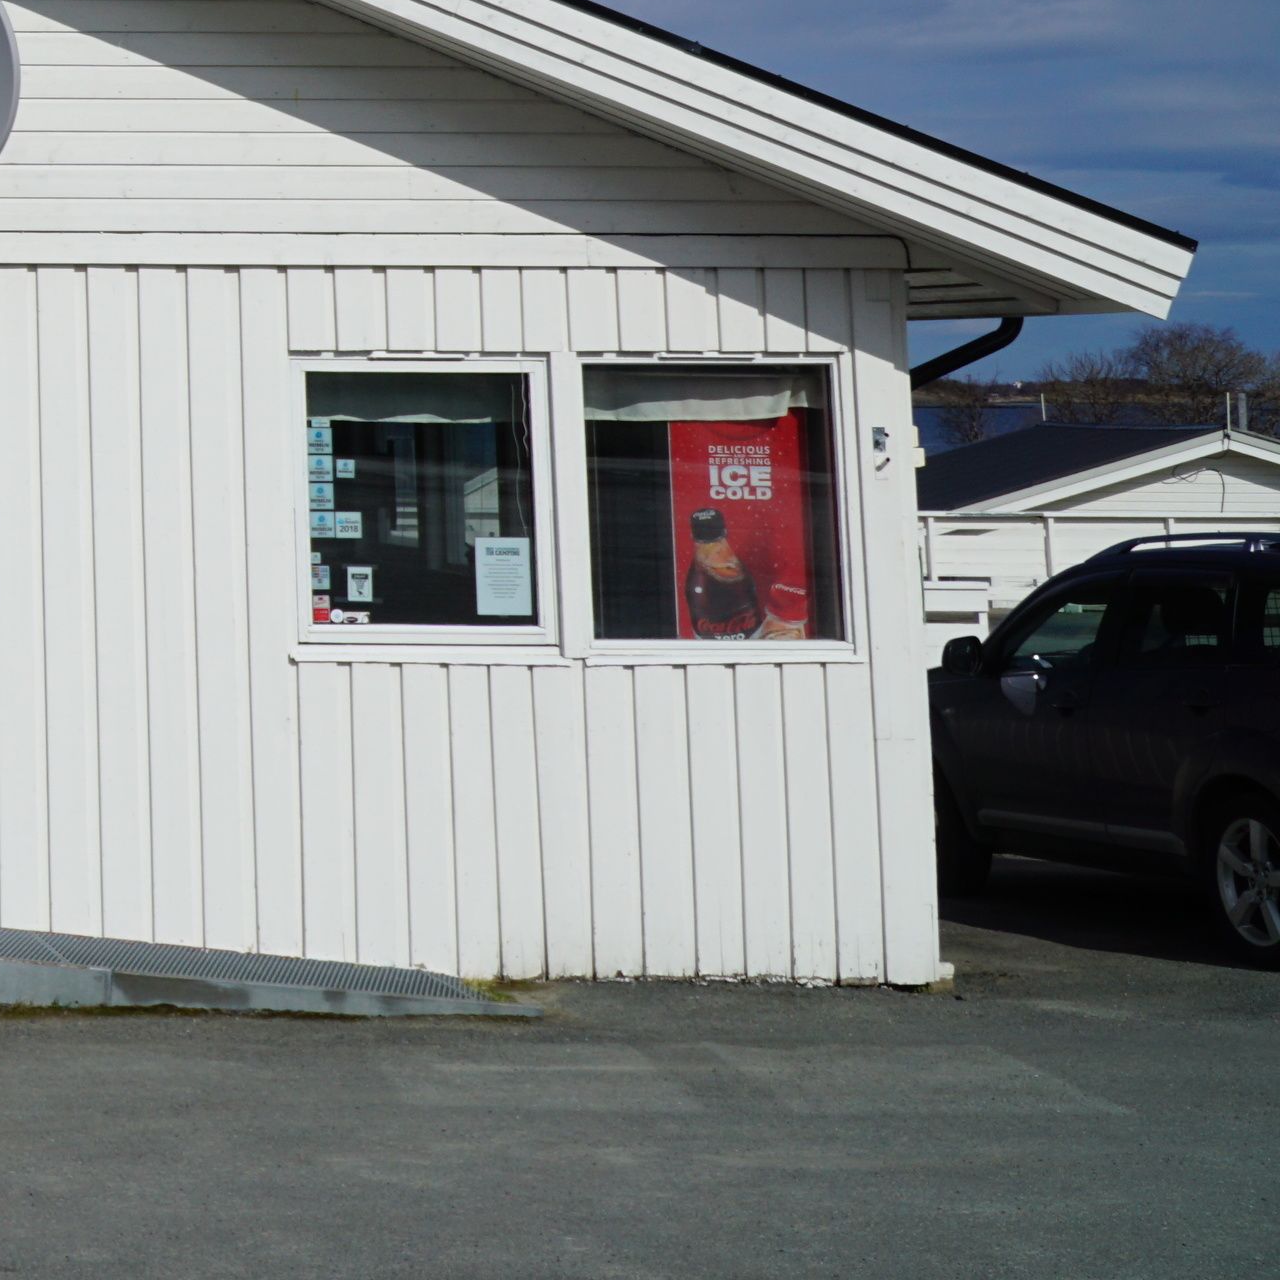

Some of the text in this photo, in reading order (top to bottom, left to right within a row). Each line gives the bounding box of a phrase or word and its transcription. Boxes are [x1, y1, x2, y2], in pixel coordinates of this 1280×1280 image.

[708, 445, 770, 454] DELICIOUS
[709, 457, 771, 465] REFRESHING
[709, 465, 772, 487] ICE
[709, 486, 772, 500] COLD
[339, 525, 359, 533] 2018
